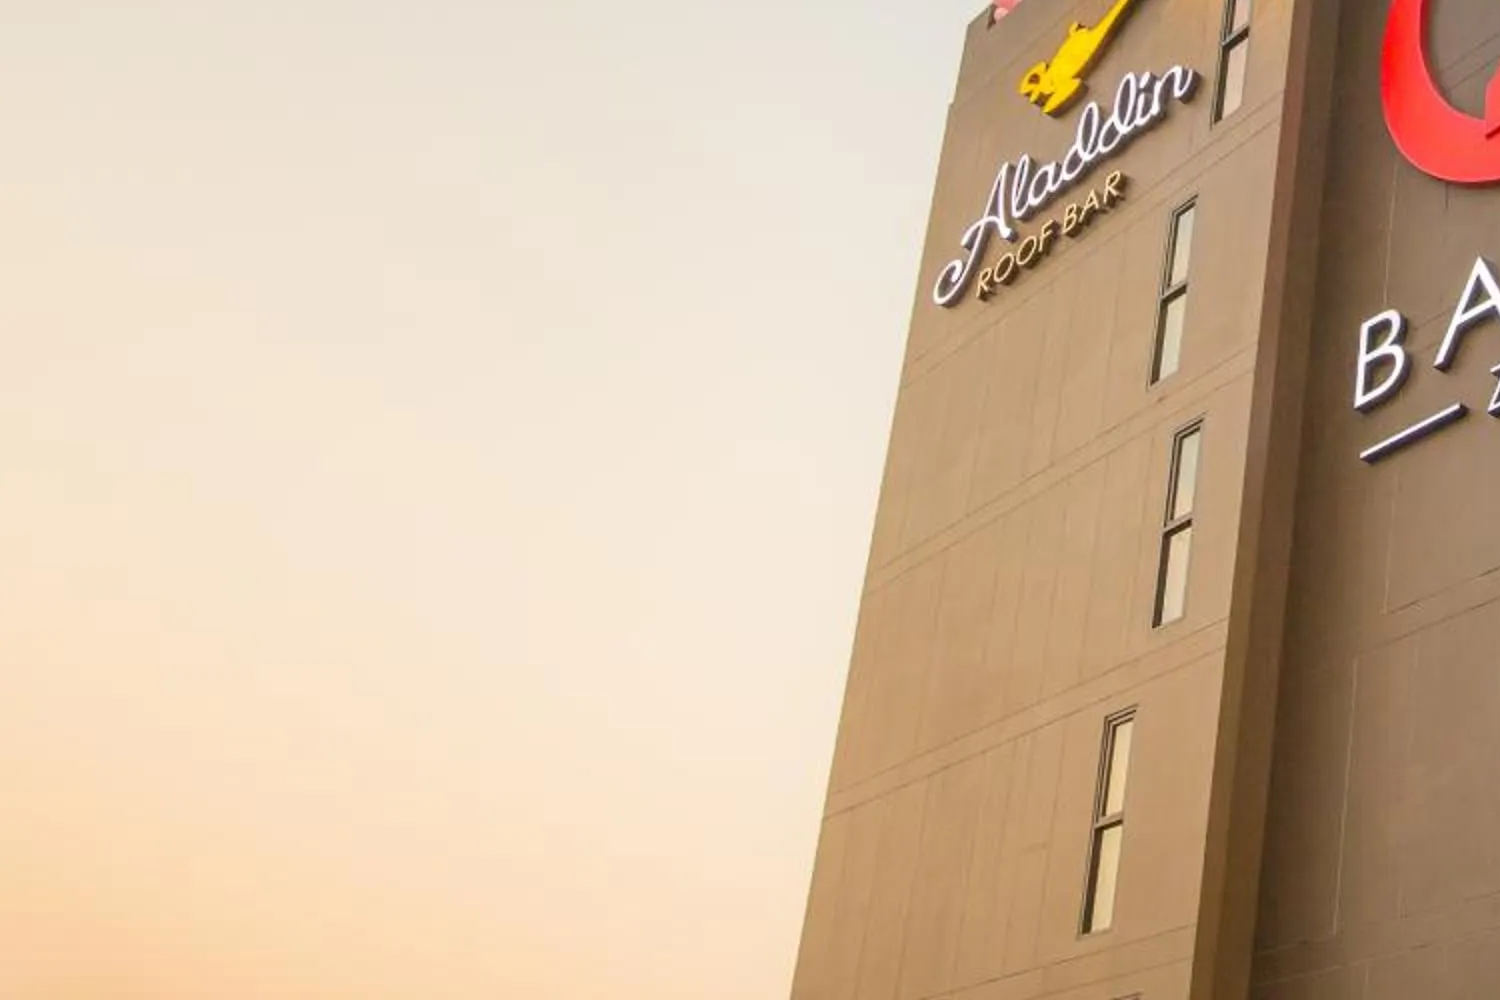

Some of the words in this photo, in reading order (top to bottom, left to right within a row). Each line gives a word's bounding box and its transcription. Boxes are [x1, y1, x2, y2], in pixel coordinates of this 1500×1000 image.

[933, 64, 1197, 307] Aladdin
[975, 220, 1054, 300] ROOF
[1061, 170, 1126, 235] BAR
